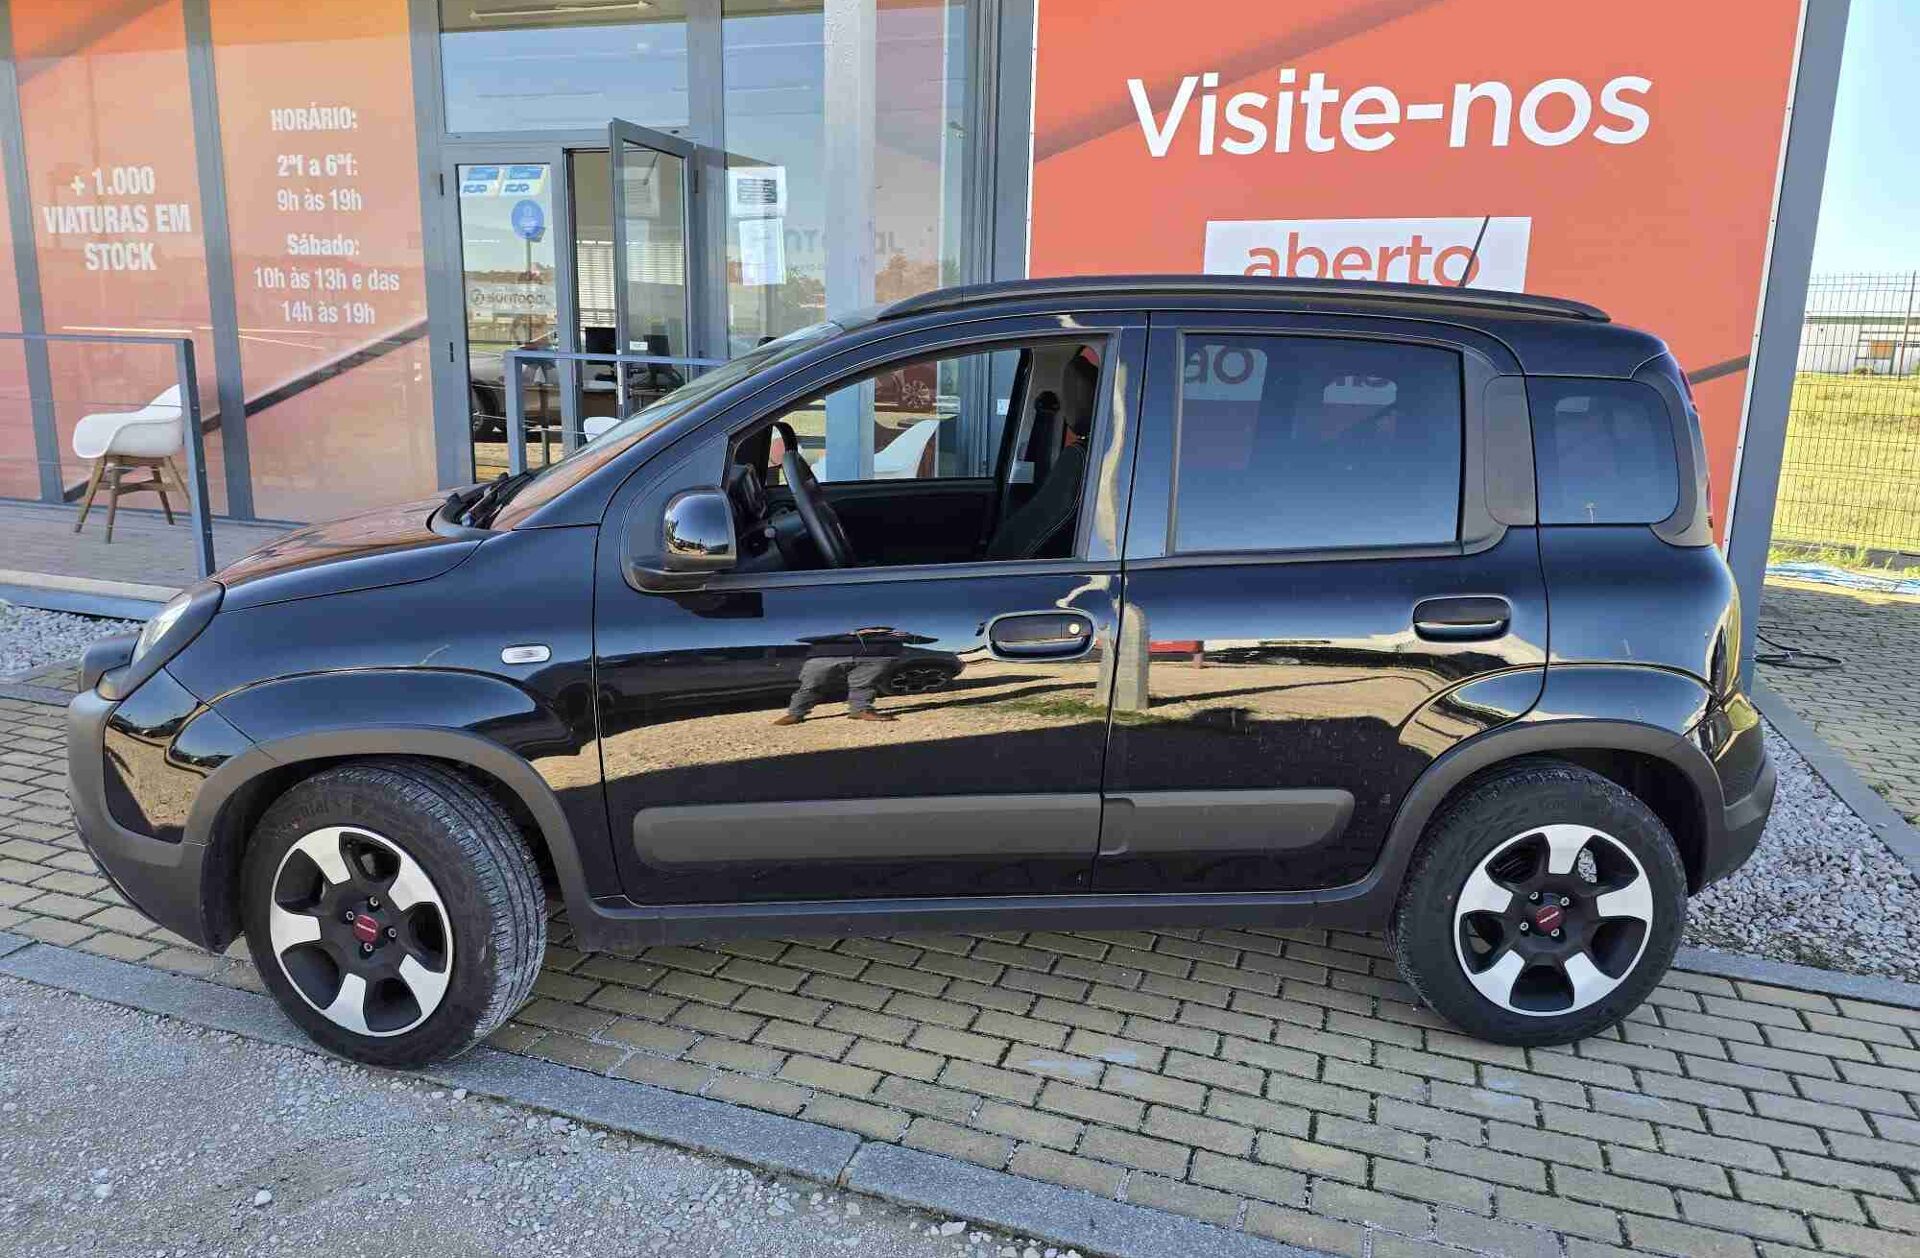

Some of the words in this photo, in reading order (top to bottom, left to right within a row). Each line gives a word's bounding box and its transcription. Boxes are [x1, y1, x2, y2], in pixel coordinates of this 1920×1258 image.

[271, 101, 358, 132] HORÁRIO:
[1126, 68, 1653, 158] Visite-nos
[70, 177, 85, 197] +
[93, 166, 155, 196] 1.000
[310, 159, 321, 176] a
[277, 189, 300, 211] 9h
[304, 189, 325, 211] às
[330, 188, 361, 211] 19h
[43, 204, 149, 234] VIATURAS
[156, 203, 192, 233] EM
[84, 242, 157, 271] STOCK
[287, 233, 360, 256] Sábado:
[1243, 231, 1481, 287] aberto
[253, 268, 284, 290] 10h
[290, 267, 310, 290] às
[315, 268, 347, 290] 13h
[352, 274, 363, 291] e
[368, 268, 400, 291] das
[281, 301, 313, 323] 14h
[318, 301, 338, 324] às
[344, 302, 375, 324] 19h
